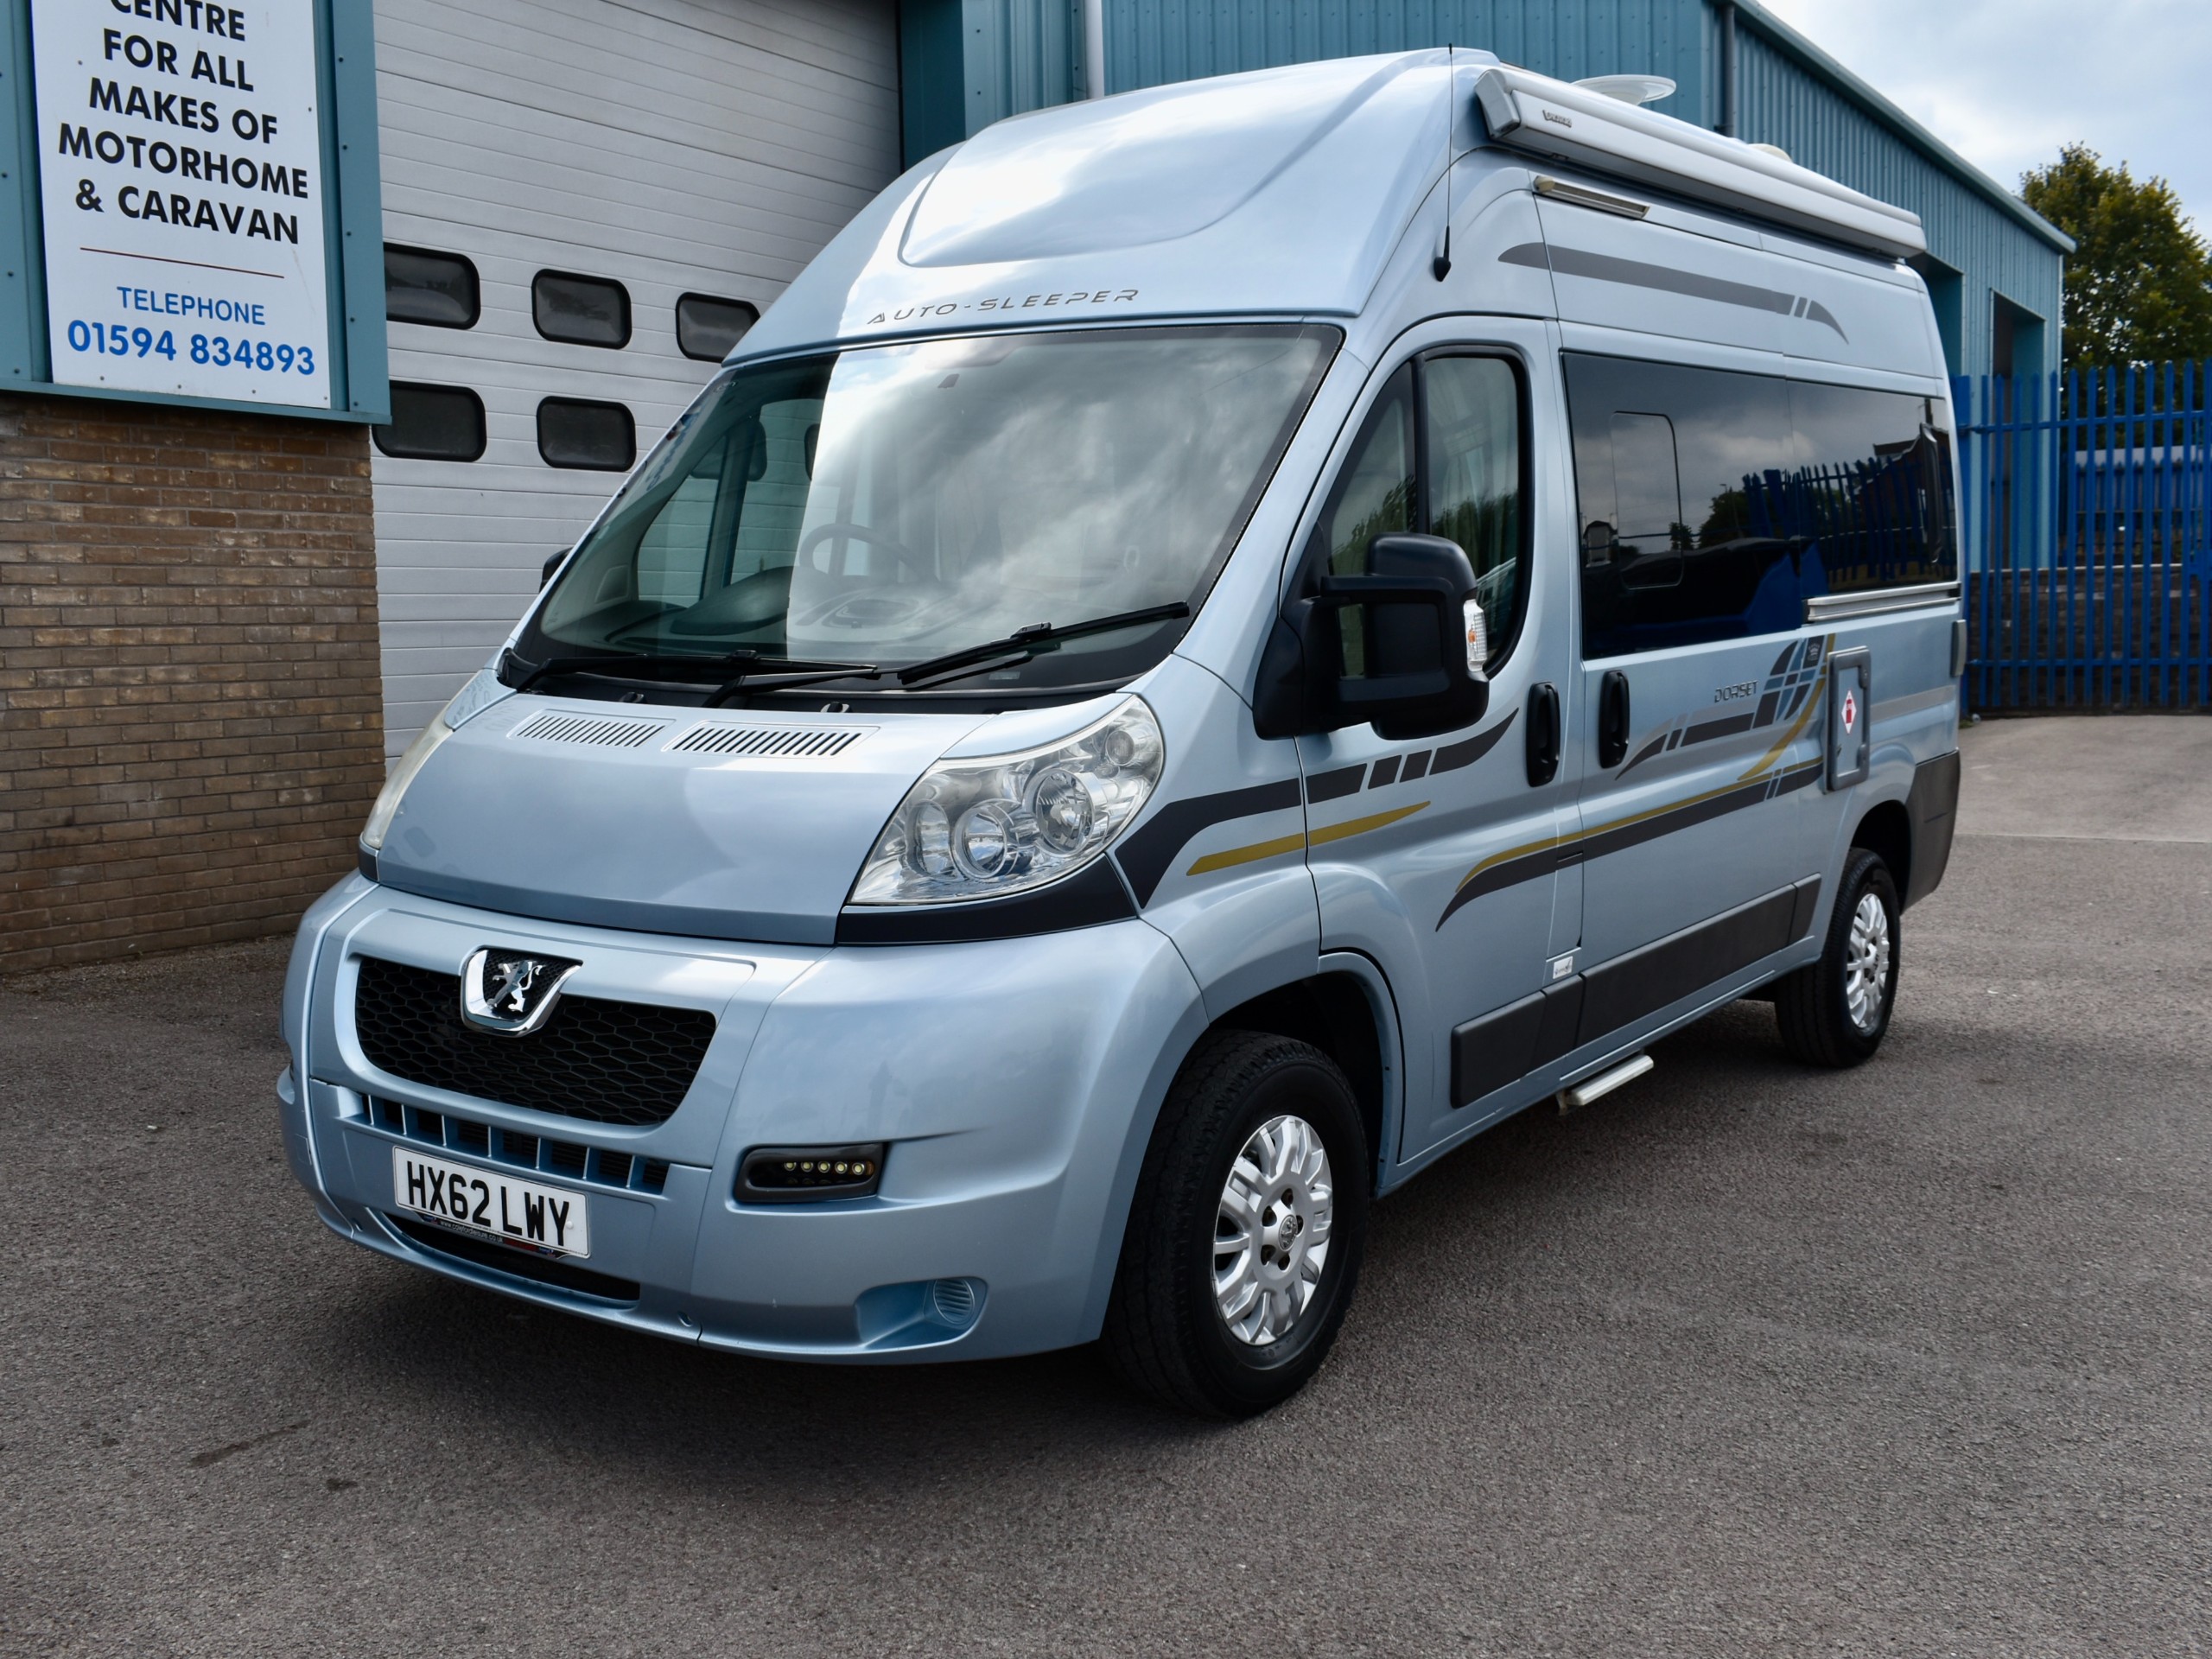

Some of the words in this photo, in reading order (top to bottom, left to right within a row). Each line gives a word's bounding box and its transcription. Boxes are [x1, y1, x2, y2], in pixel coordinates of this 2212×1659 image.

[104, 28, 179, 75] FOR
[191, 50, 254, 92] ALL
[89, 77, 219, 133] MAKES
[232, 109, 277, 143] OF
[59, 123, 308, 199] MOTORHOME
[75, 179, 105, 213] &
[118, 185, 298, 244] CARAVAN
[116, 286, 265, 326] TELEPHONE
[866, 289, 1139, 325] AUTO-SLEEPER
[67, 320, 177, 361] 01594
[190, 334, 315, 376] 834893
[1714, 680, 1758, 703] DORSET
[407, 1160, 492, 1228] HX62
[501, 1185, 569, 1247] LWY
